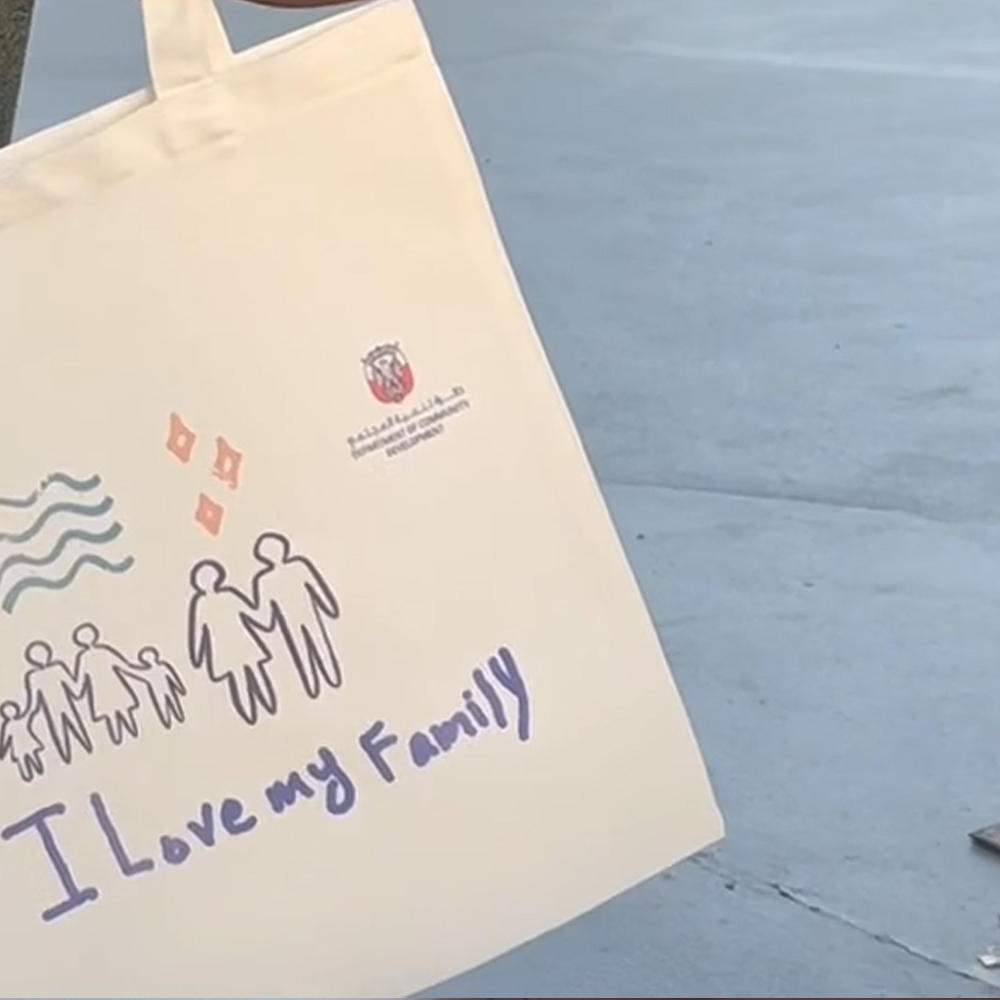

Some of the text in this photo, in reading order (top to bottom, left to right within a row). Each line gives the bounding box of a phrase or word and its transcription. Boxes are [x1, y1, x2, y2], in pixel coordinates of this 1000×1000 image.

[350, 427, 406, 461] DEPARTMENT
[405, 421, 418, 435] OF
[1, 646, 530, 921] I Love my Family
